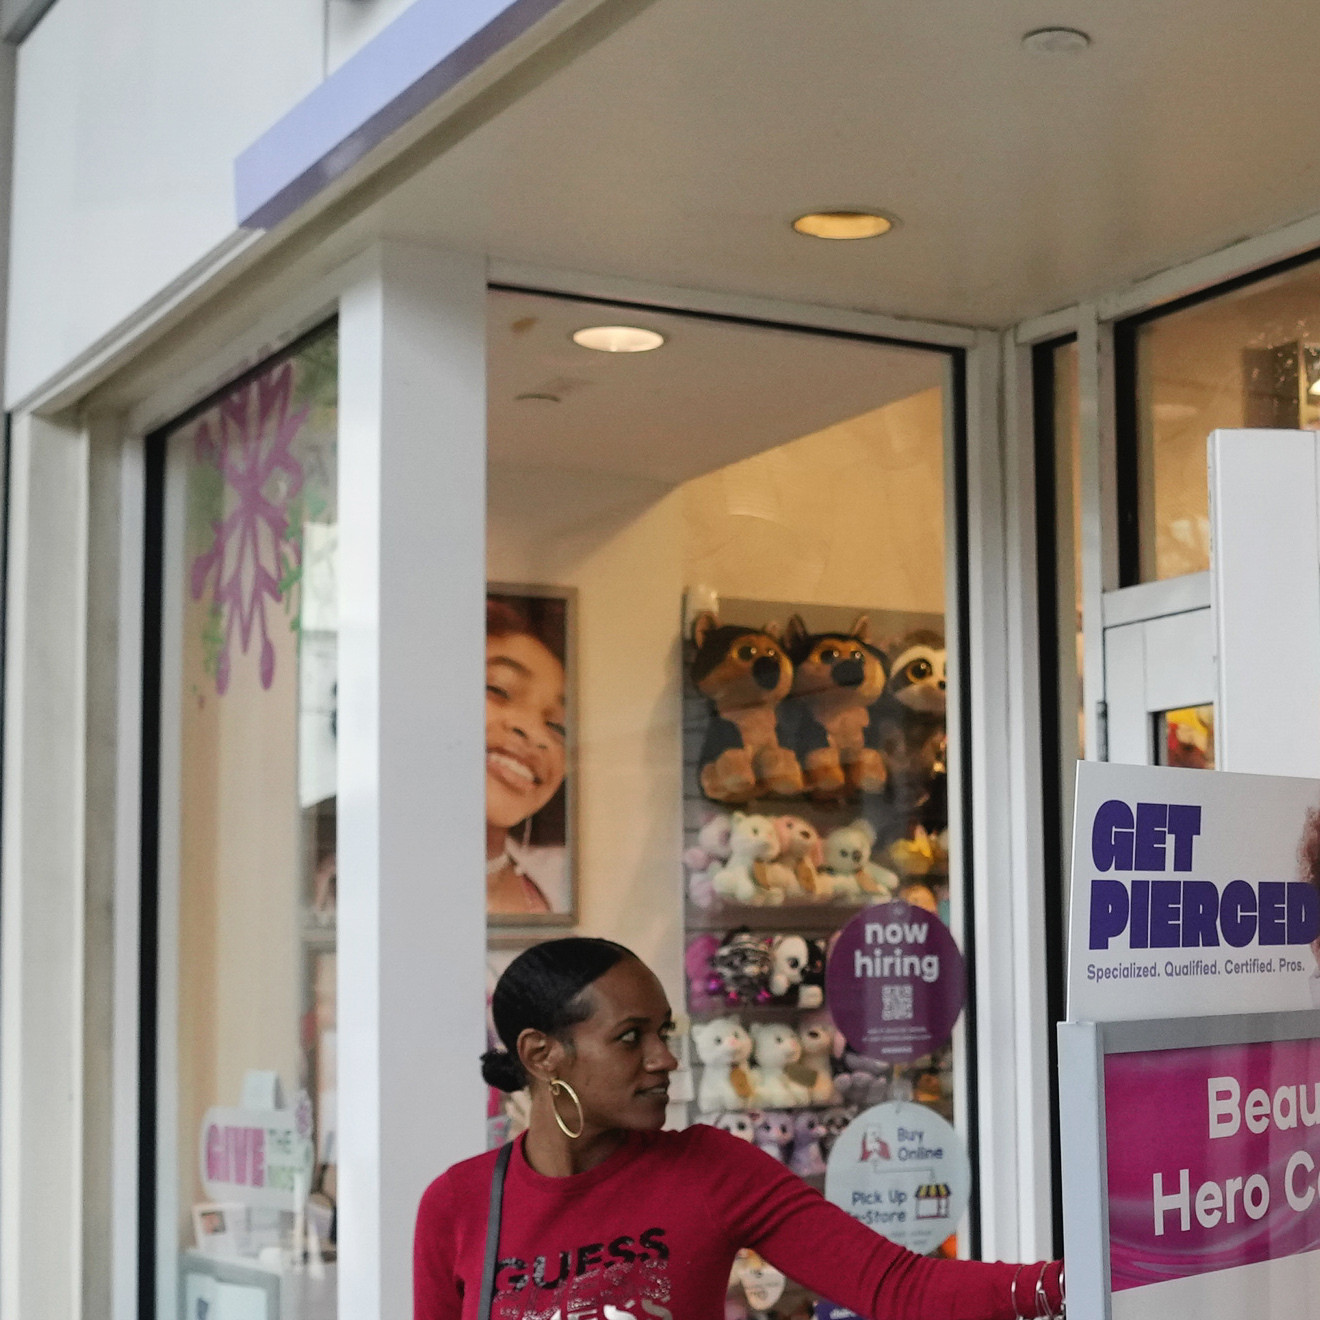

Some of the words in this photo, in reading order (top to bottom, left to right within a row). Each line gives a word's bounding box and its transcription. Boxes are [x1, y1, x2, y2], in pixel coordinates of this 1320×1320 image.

[1092, 800, 1201, 872] GET
[1089, 880, 1320, 950] PIERCED
[865, 922, 928, 945] now
[854, 948, 940, 983] hiring
[1087, 962, 1161, 983] Specialized.
[1164, 959, 1221, 977] Qualified.
[1224, 958, 1276, 974] Certified.
[1279, 957, 1306, 973] Pros.
[897, 1127, 924, 1142] Buy
[898, 1147, 943, 1161] Online
[852, 1190, 882, 1205] Pick
[888, 1189, 907, 1204] Up
[1153, 1168, 1270, 1236] Hero
[497, 1227, 670, 1291] GUESS
